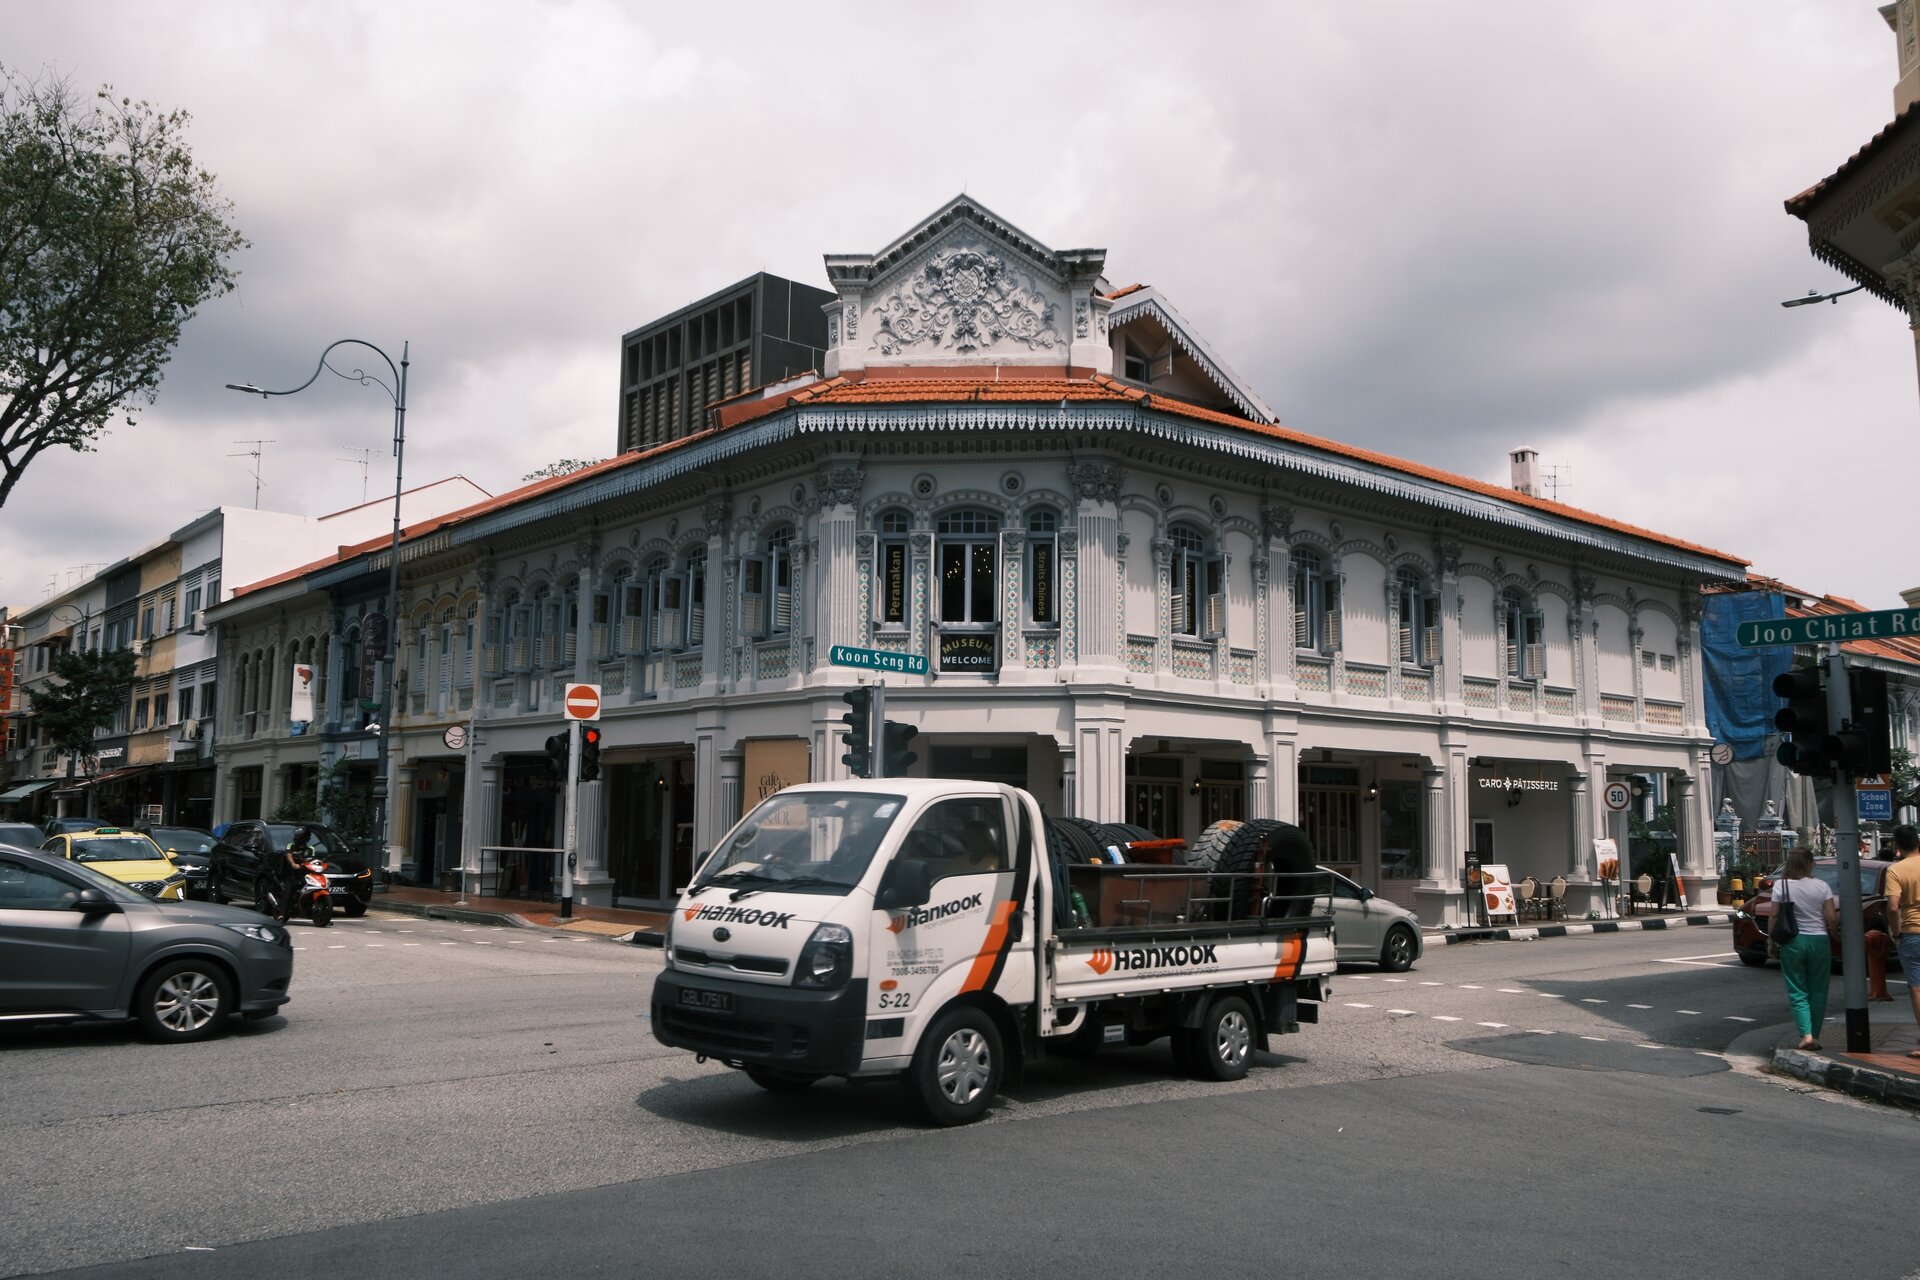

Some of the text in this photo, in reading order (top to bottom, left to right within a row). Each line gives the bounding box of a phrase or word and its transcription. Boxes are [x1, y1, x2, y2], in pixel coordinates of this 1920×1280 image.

[890, 551, 901, 617] Peranakan
[1038, 551, 1047, 616] Straits Chinese
[1750, 612, 1920, 644] Joo Chiat Rd
[941, 638, 993, 654] MUSEUM
[837, 648, 923, 671] Koon Seng Rd
[942, 656, 992, 665] WELCOME
[1480, 777, 1558, 791] CARO PÂTISSERIE
[1611, 790, 1624, 803] 50
[1861, 792, 1887, 801] School
[1865, 801, 1884, 810] Zone
[879, 992, 911, 1008] S-22
